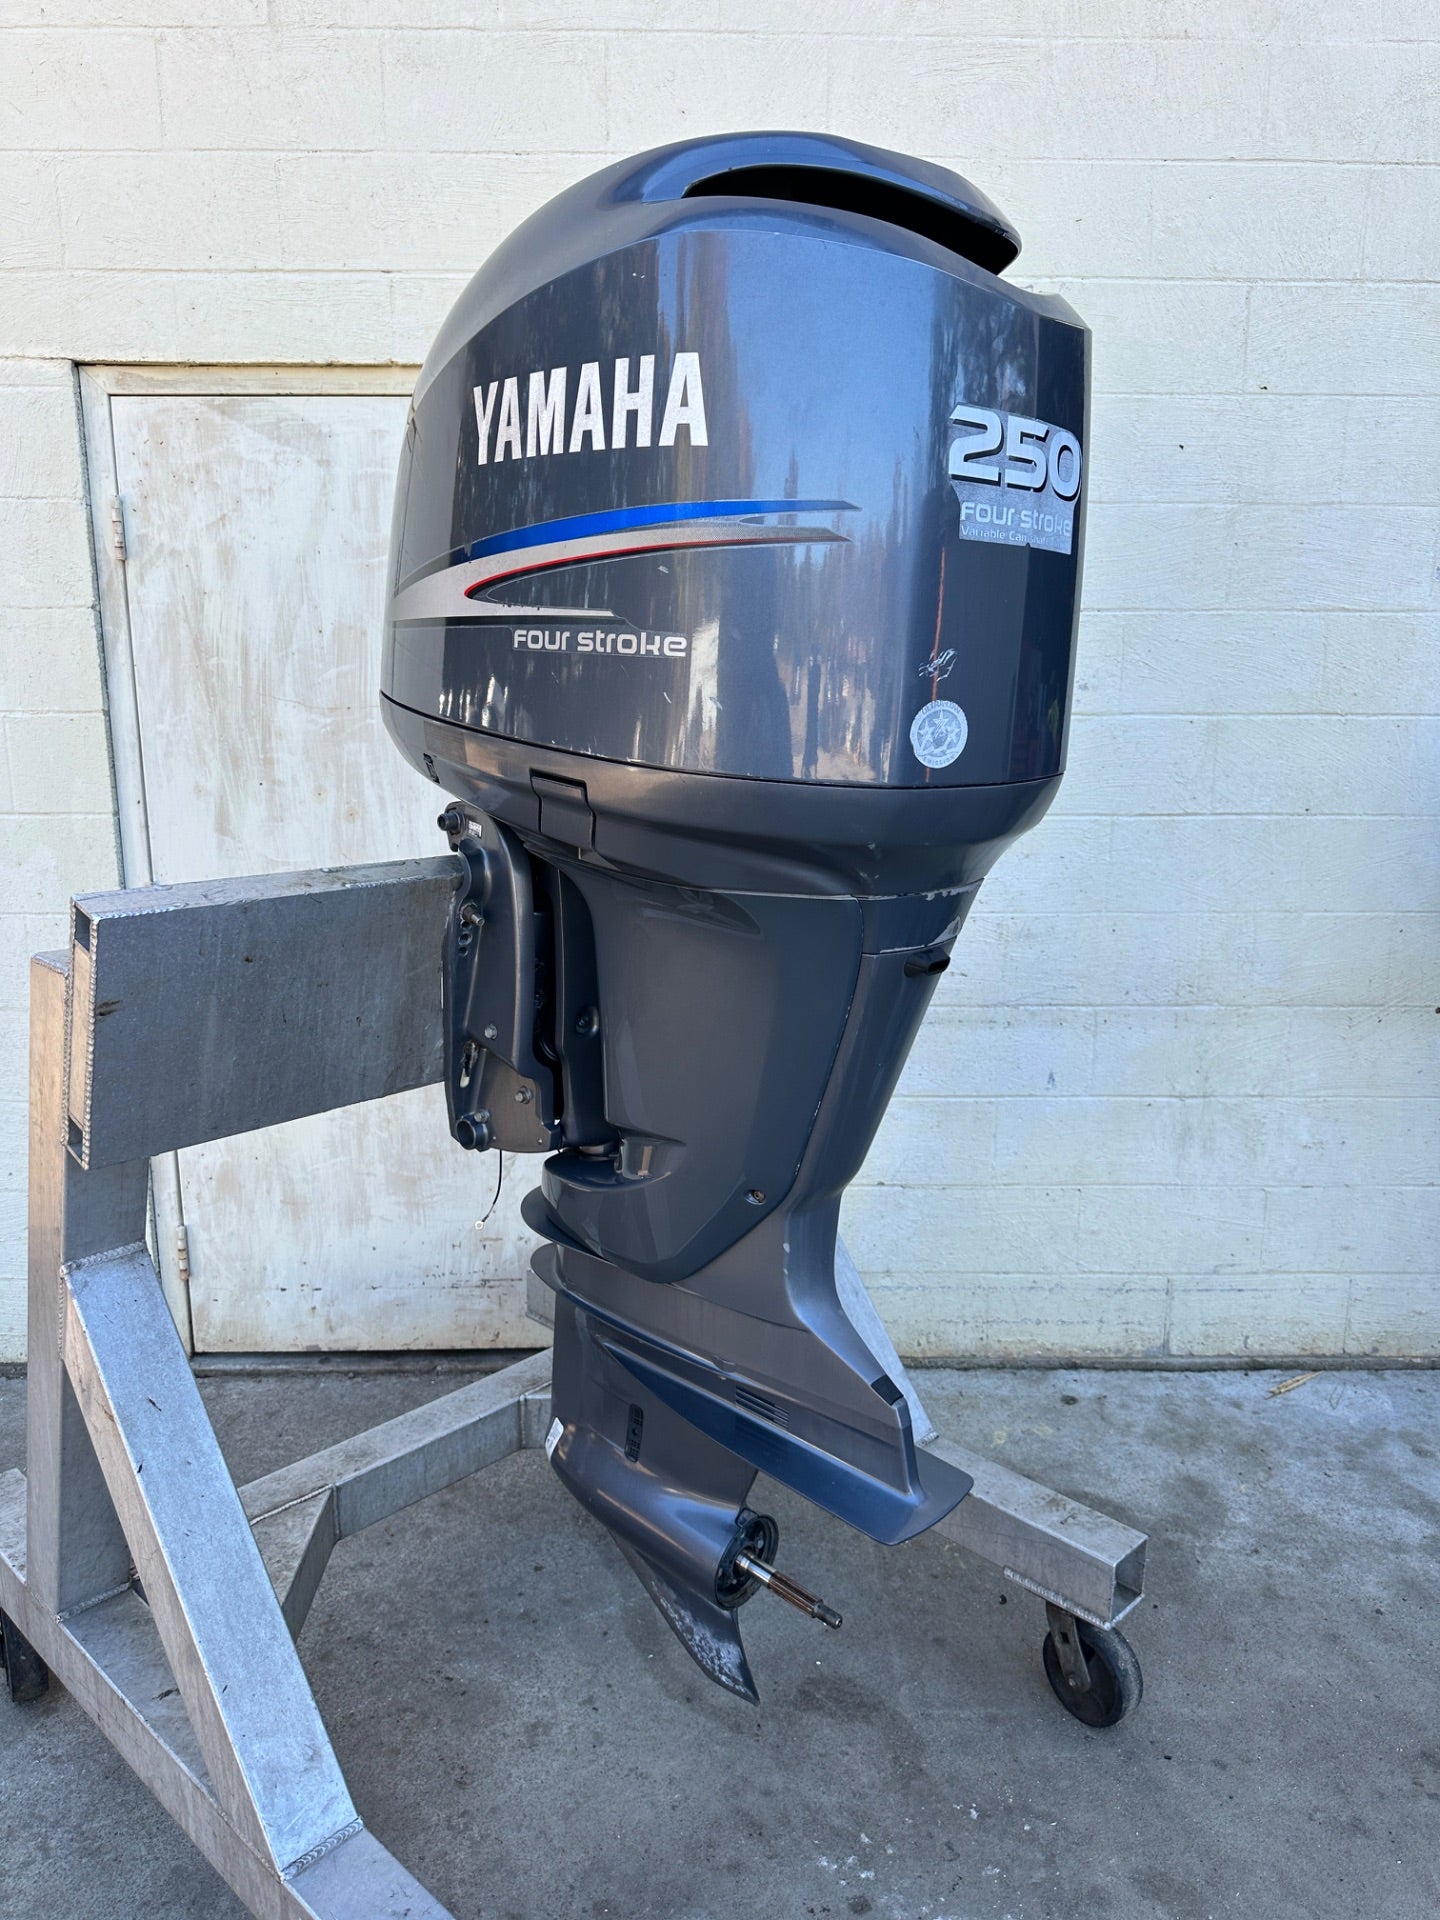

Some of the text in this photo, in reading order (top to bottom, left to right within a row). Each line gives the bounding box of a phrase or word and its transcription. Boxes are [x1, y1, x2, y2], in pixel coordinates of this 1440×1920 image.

[473, 352, 708, 466] YAMAHA
[949, 404, 1082, 500] 250
[961, 525, 1006, 539] Variable
